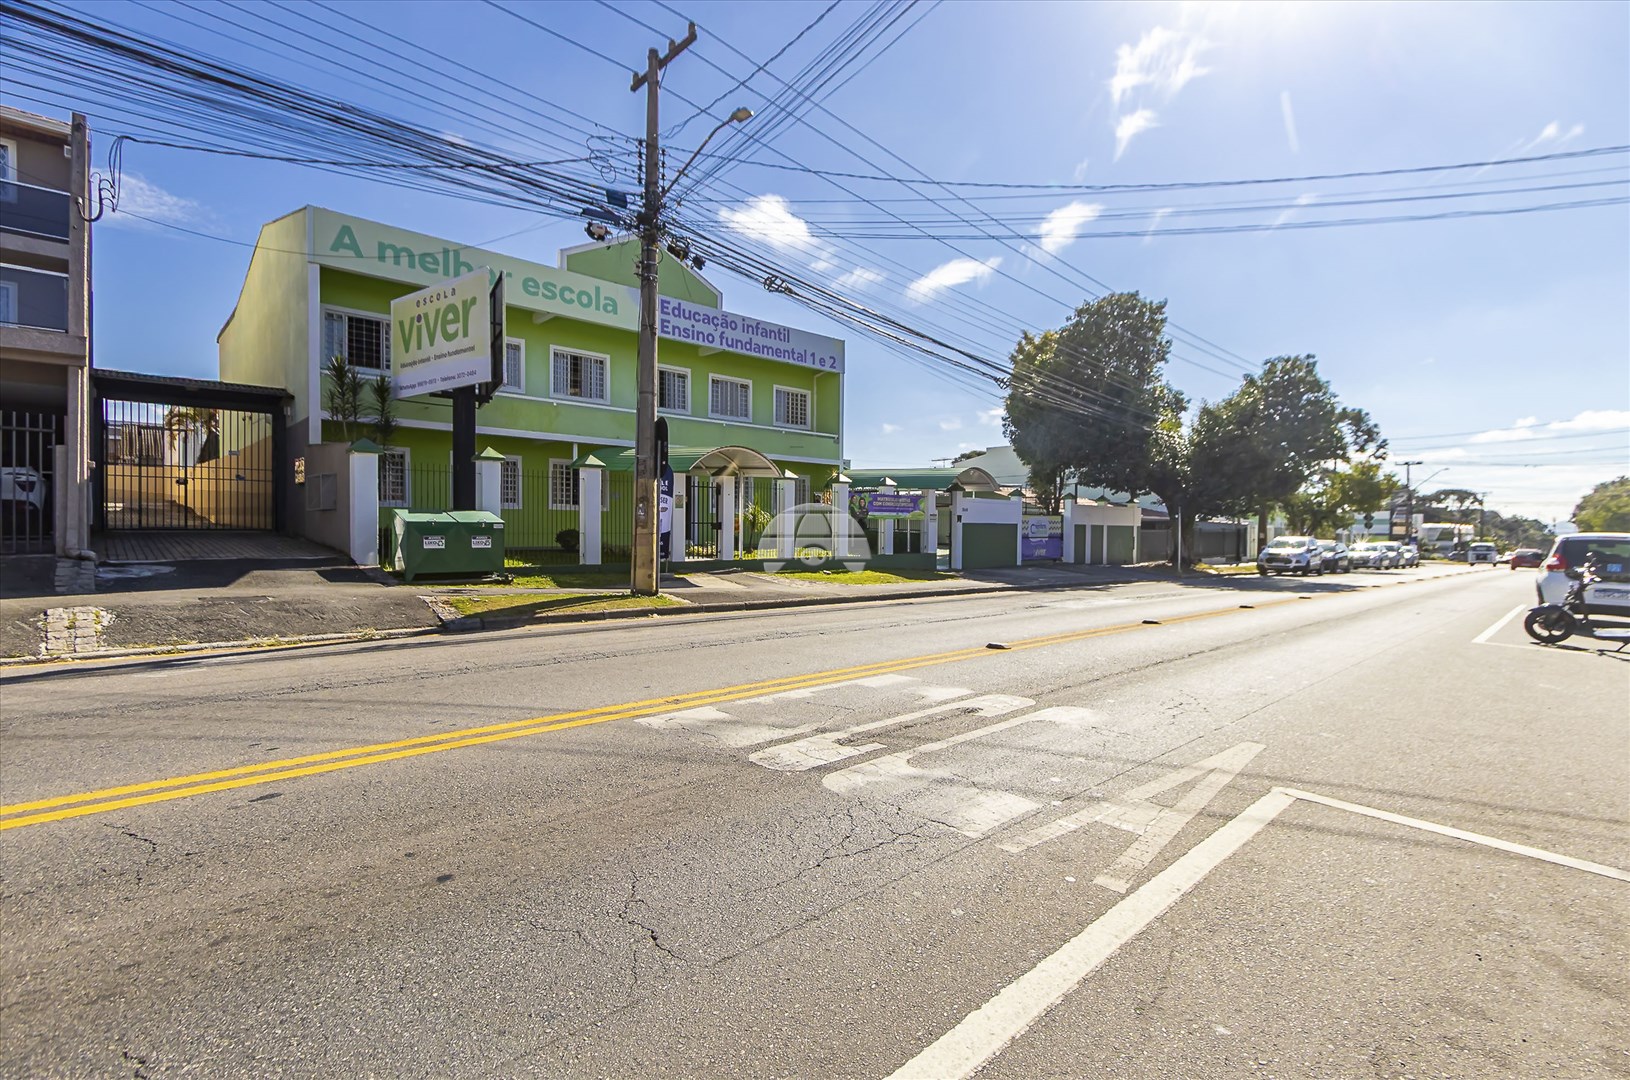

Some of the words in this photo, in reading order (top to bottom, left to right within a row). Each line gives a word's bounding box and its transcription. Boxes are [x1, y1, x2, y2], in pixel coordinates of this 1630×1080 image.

[329, 224, 364, 259] A
[377, 240, 513, 287] melh
[521, 276, 619, 315] escola
[398, 296, 477, 354] viver
[660, 298, 738, 331] Educação
[741, 317, 790, 343] infantil
[660, 319, 715, 345] Ensino
[718, 331, 807, 364] fundamental
[810, 353, 816, 365] 1
[819, 357, 826, 367] e
[829, 356, 837, 369] 2
[632, 674, 1266, 894] ESCOA
